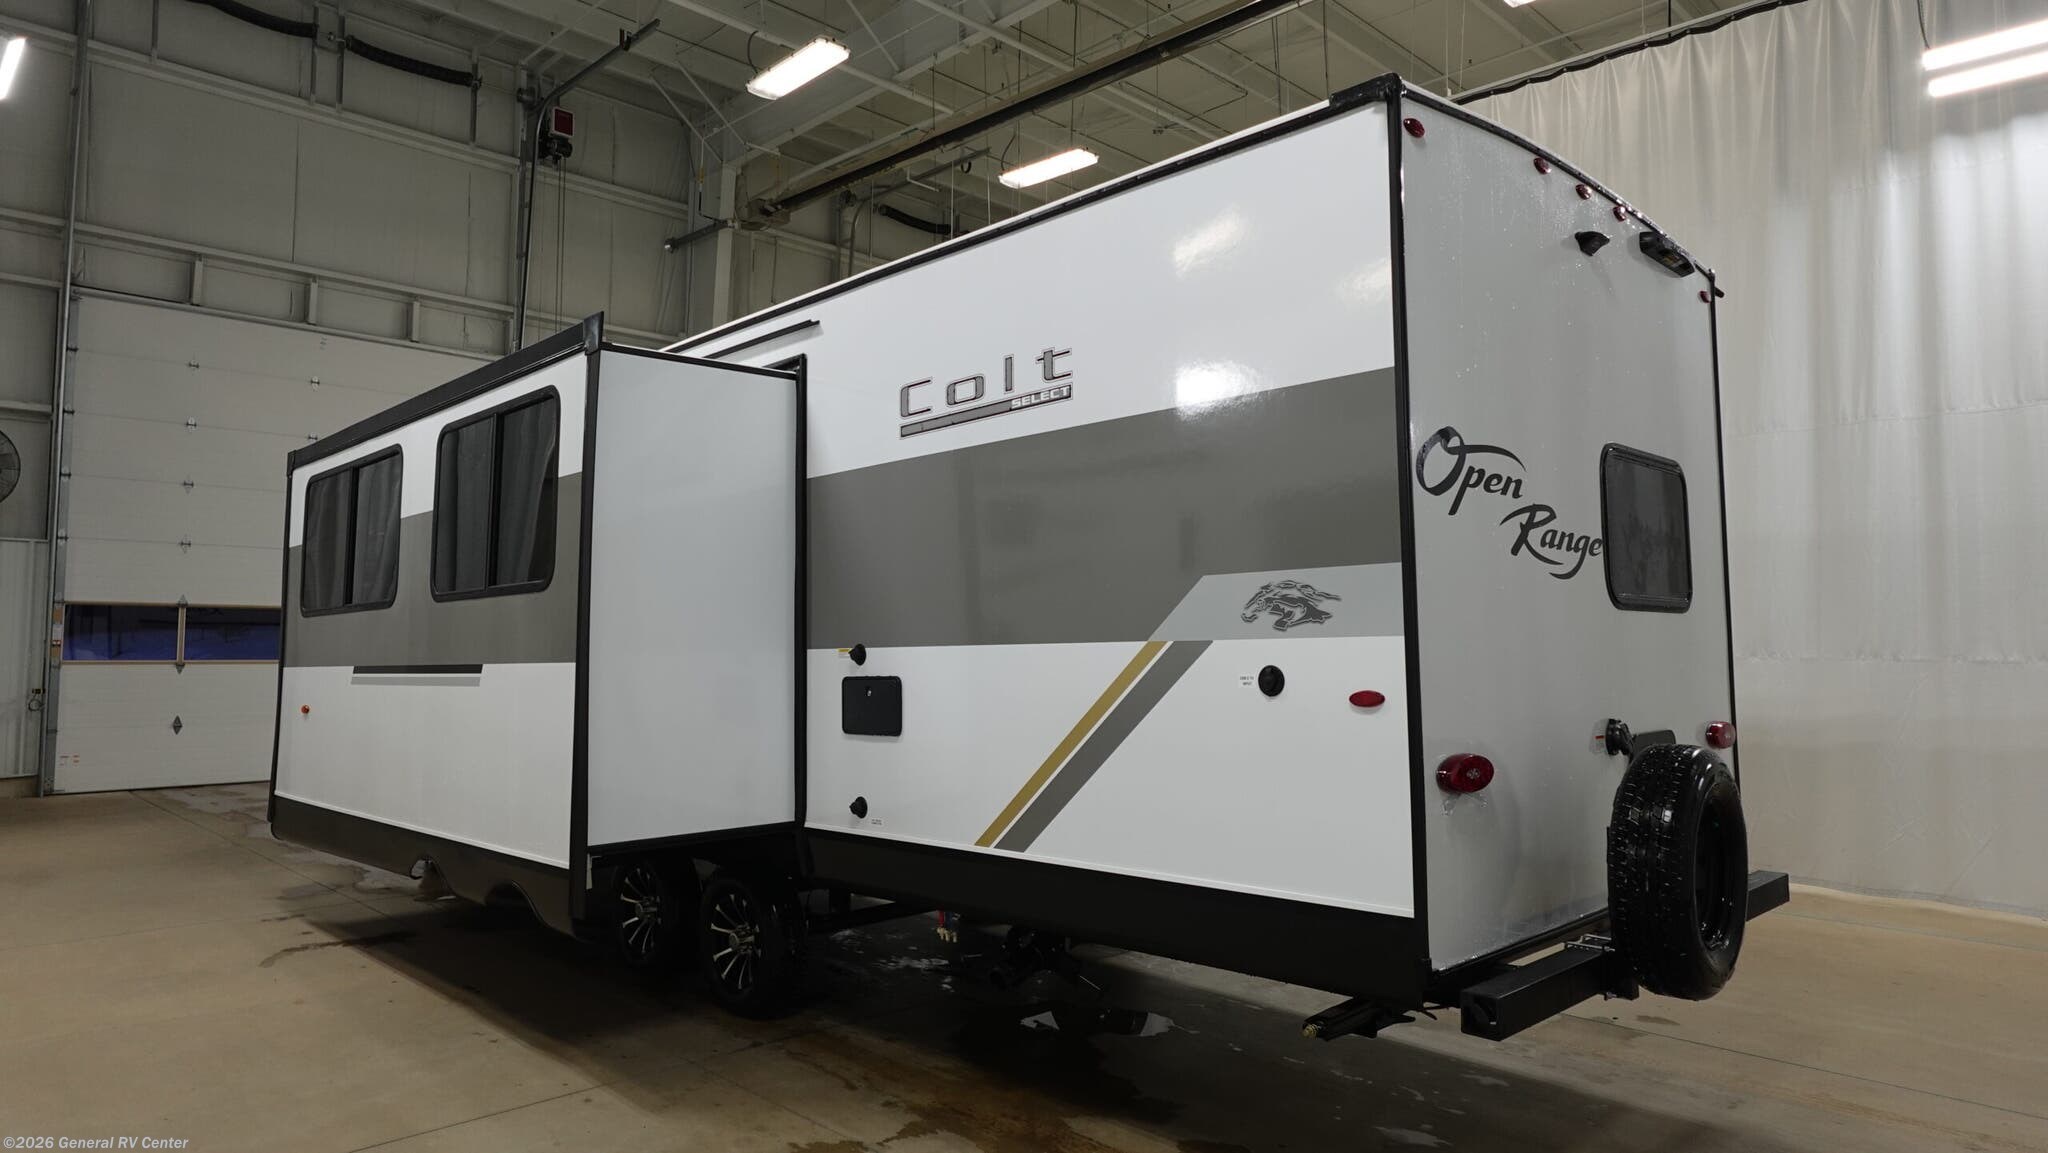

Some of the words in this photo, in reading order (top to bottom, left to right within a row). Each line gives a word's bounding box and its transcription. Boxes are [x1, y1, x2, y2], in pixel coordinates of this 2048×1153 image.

[899, 347, 1072, 418] Colt
[1010, 385, 1071, 411] SELECT
[1415, 425, 1527, 516] Open
[1499, 503, 1604, 580] Range
